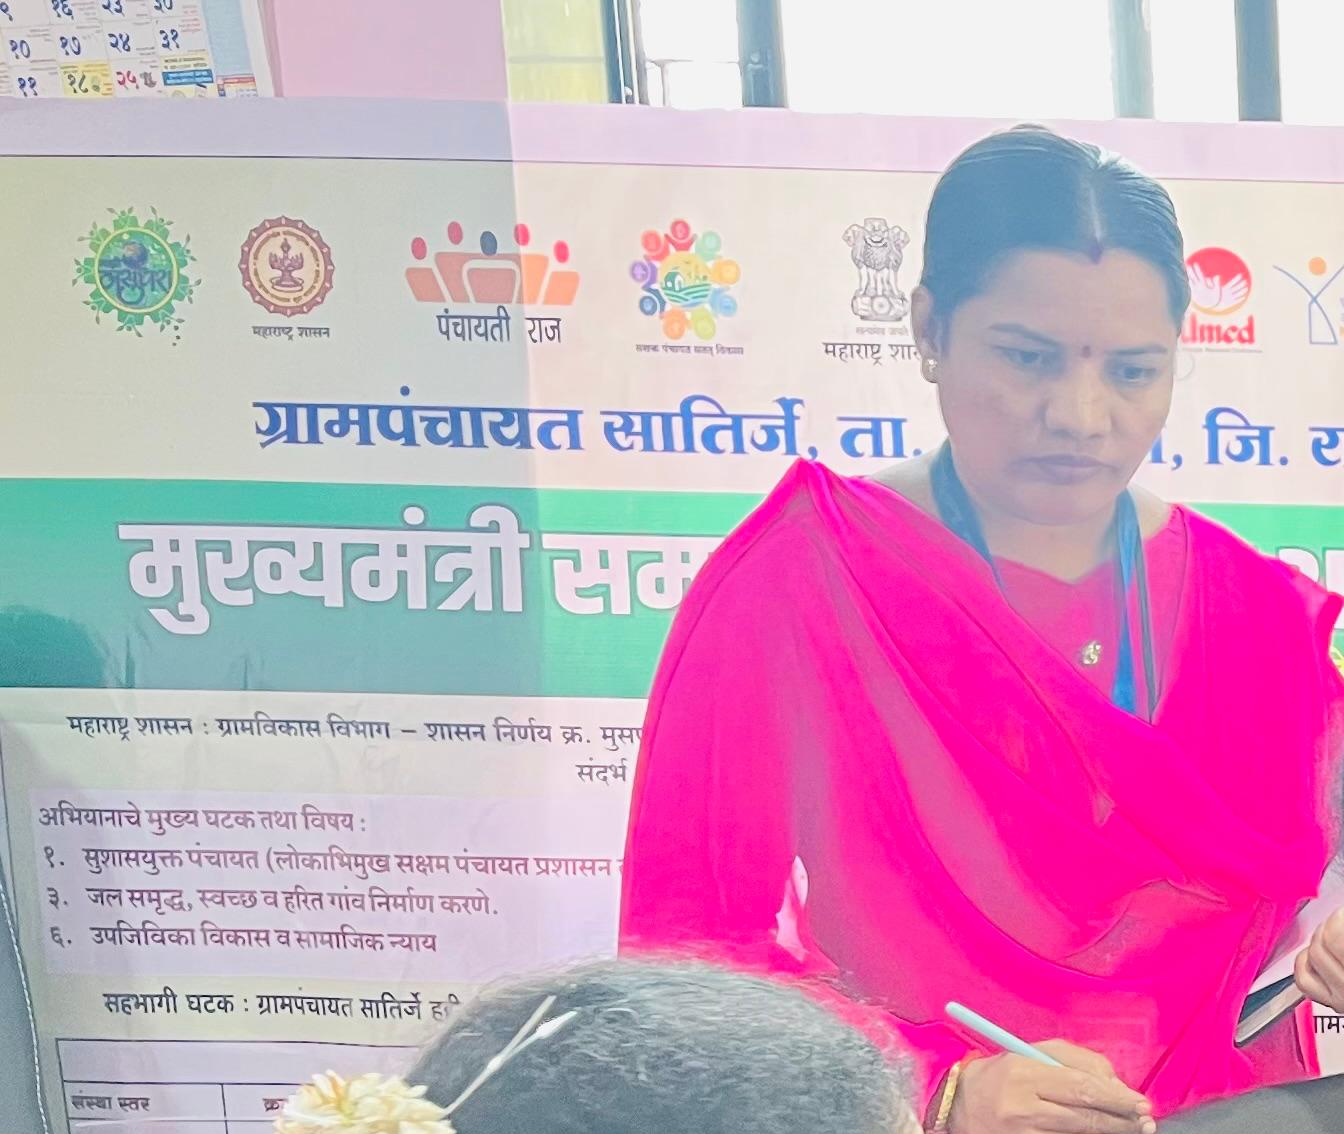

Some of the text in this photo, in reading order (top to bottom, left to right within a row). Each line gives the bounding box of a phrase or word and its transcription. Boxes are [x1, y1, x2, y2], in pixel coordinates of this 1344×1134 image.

[9, 29, 180, 59] १० १७ २४ ३१
[17, 77, 37, 97] ११
[116, 71, 139, 90] २५
[252, 326, 331, 341] महाराष्ट्र शासन
[436, 305, 561, 343] पंचायती राज
[823, 342, 883, 366] महाराष्ट्र
[252, 386, 923, 462] ग्रामपंचायत सातिर्जे, ता.
[1203, 407, 1289, 466] जि.
[119, 505, 529, 635] मुख्यमंत्री
[66, 716, 130, 741] महाराष्ट्र
[134, 717, 193, 736] शासन
[216, 711, 322, 738] ग्रामविकास
[327, 712, 391, 739] विभाग
[424, 721, 486, 742] शासन
[493, 717, 552, 743] निर्णय
[560, 725, 591, 744] क्र.
[576, 757, 628, 785] संदर्भ
[39, 800, 141, 827] अभियानाचे
[145, 810, 198, 835] मुख्य
[202, 810, 255, 829] घटक
[257, 811, 297, 830] तथा
[301, 804, 354, 831] विषय
[44, 845, 65, 868] १.
[82, 848, 183, 874] सुशासयुक्त
[186, 842, 259, 869] पंचायत
[266, 843, 390, 880] (लोकाभिमुख
[394, 855, 450, 876] सक्षम
[454, 848, 529, 876] पंचायत
[534, 857, 612, 877] प्रशासन
[47, 885, 498, 915] ३. जल समृद्ध, स्वच्छ व हरित गांव निर्माण करणे.
[90, 920, 195, 947] उपजिविका
[201, 920, 270, 947] विकास
[274, 930, 289, 947] व
[294, 924, 384, 951] सामाजिक
[387, 934, 437, 952] न्याय
[103, 986, 178, 1015] सहभागी
[186, 994, 234, 1014] घटक
[256, 987, 353, 1017] ग्रामपंचायत
[360, 991, 422, 1020] सातिर्जे
